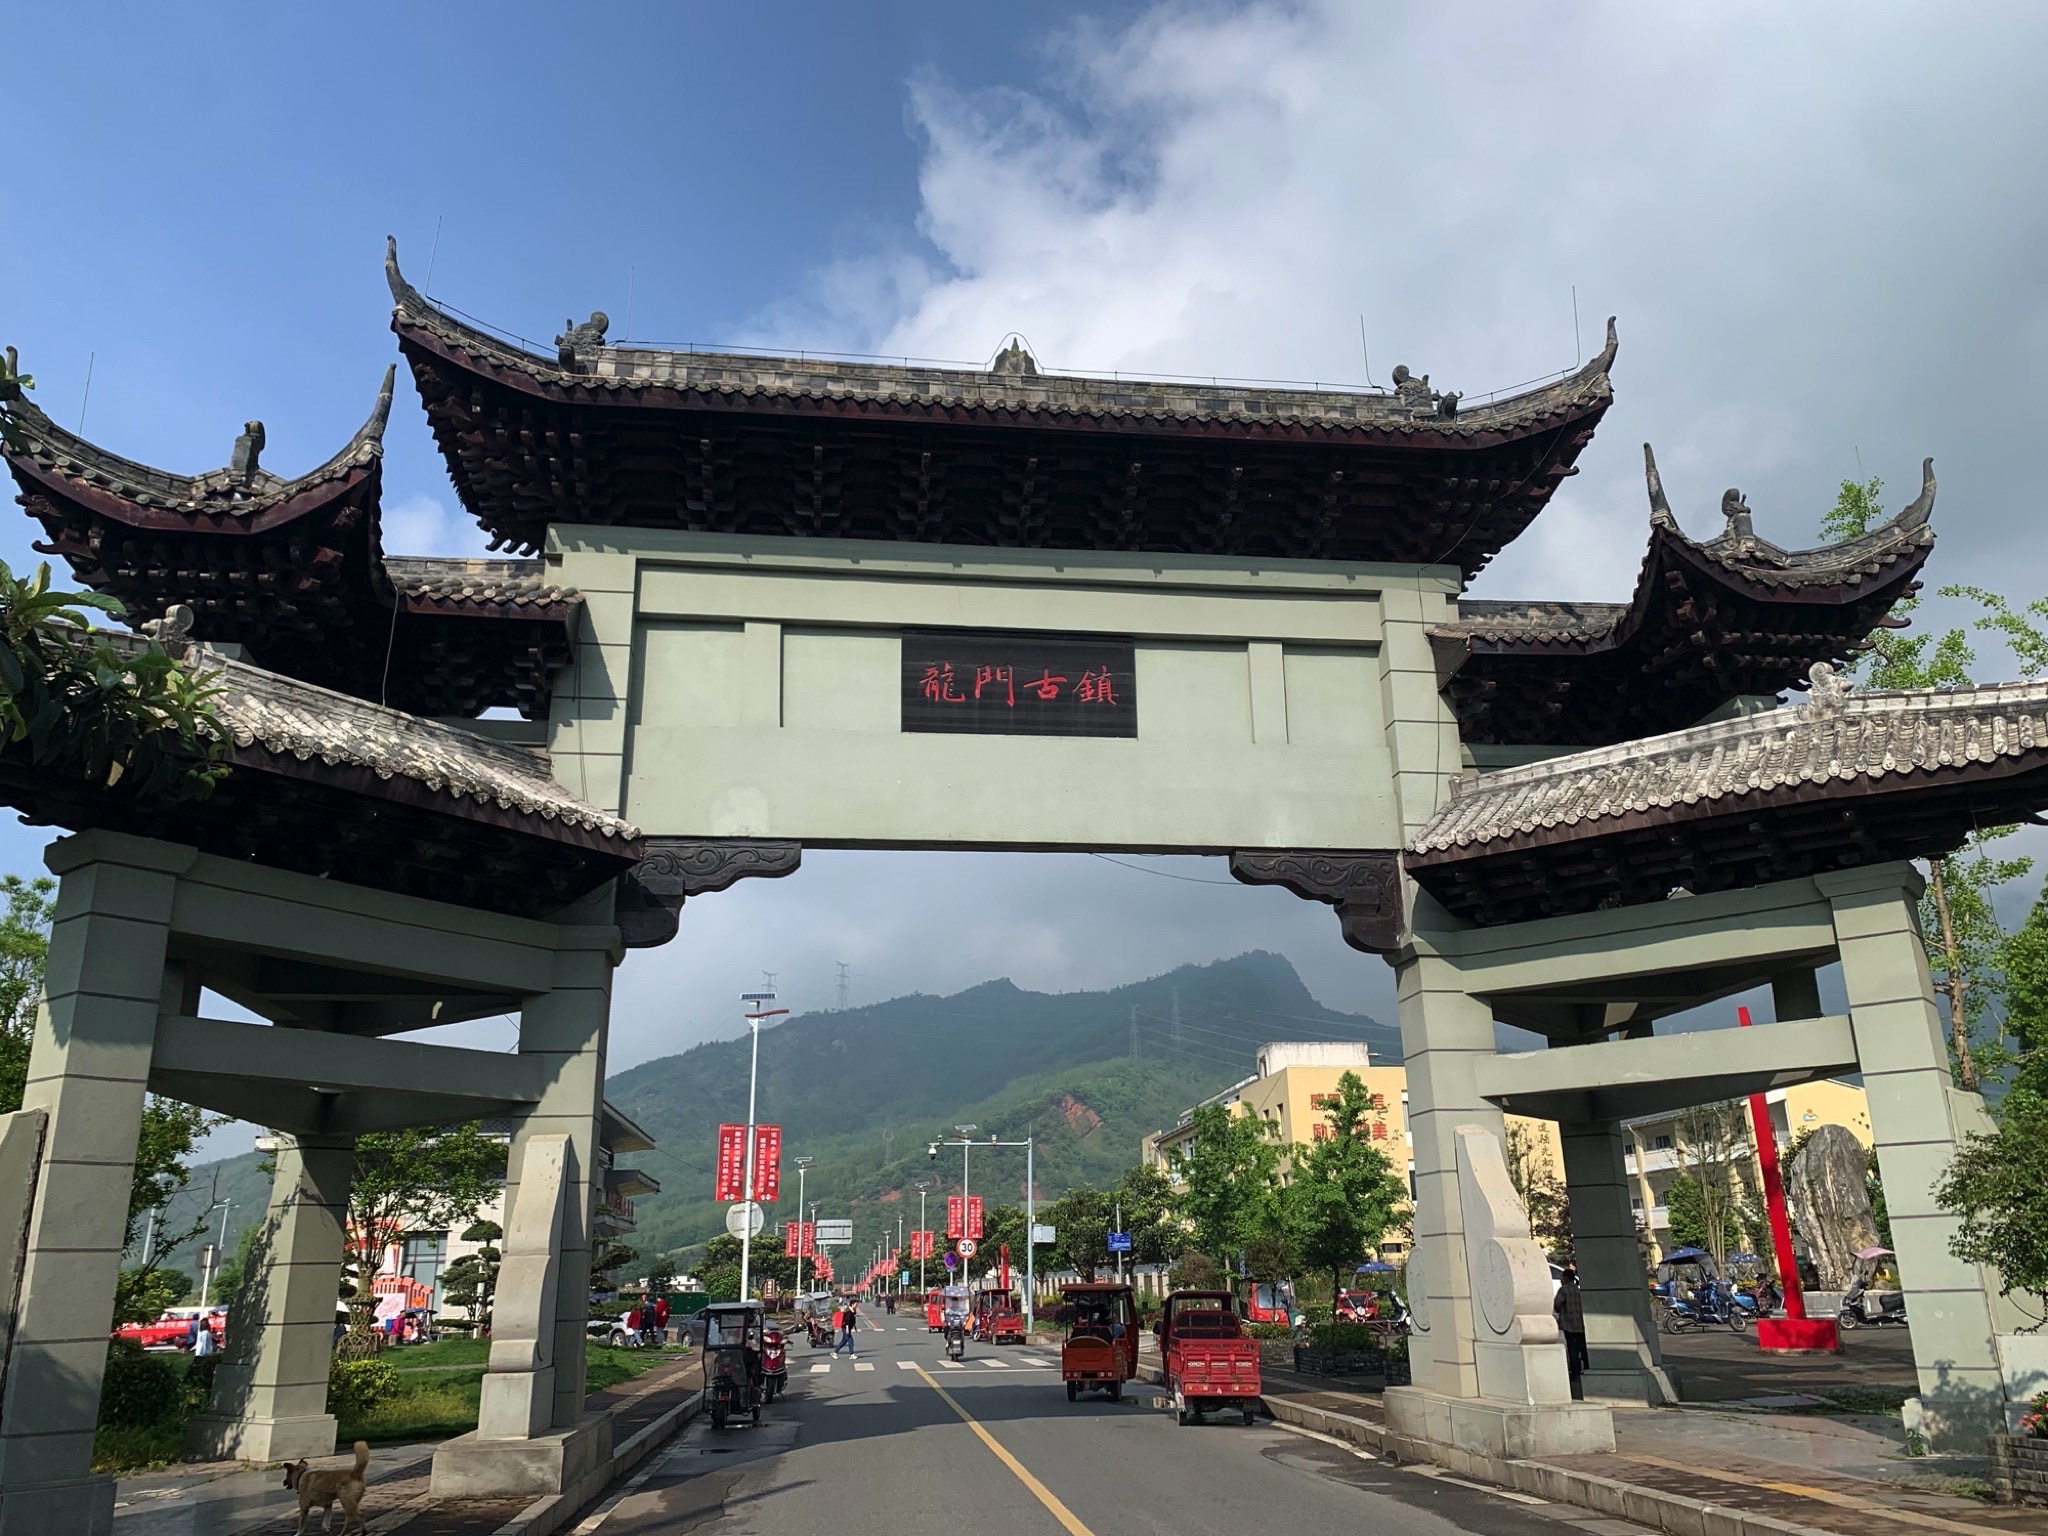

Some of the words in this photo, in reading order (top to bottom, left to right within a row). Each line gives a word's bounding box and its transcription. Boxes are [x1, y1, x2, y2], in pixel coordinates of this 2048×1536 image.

[919, 660, 1120, 707] 龍門古鎮
[768, 1132, 777, 1187] 实施乡村振兴战略
[961, 1243, 973, 1252] 30
